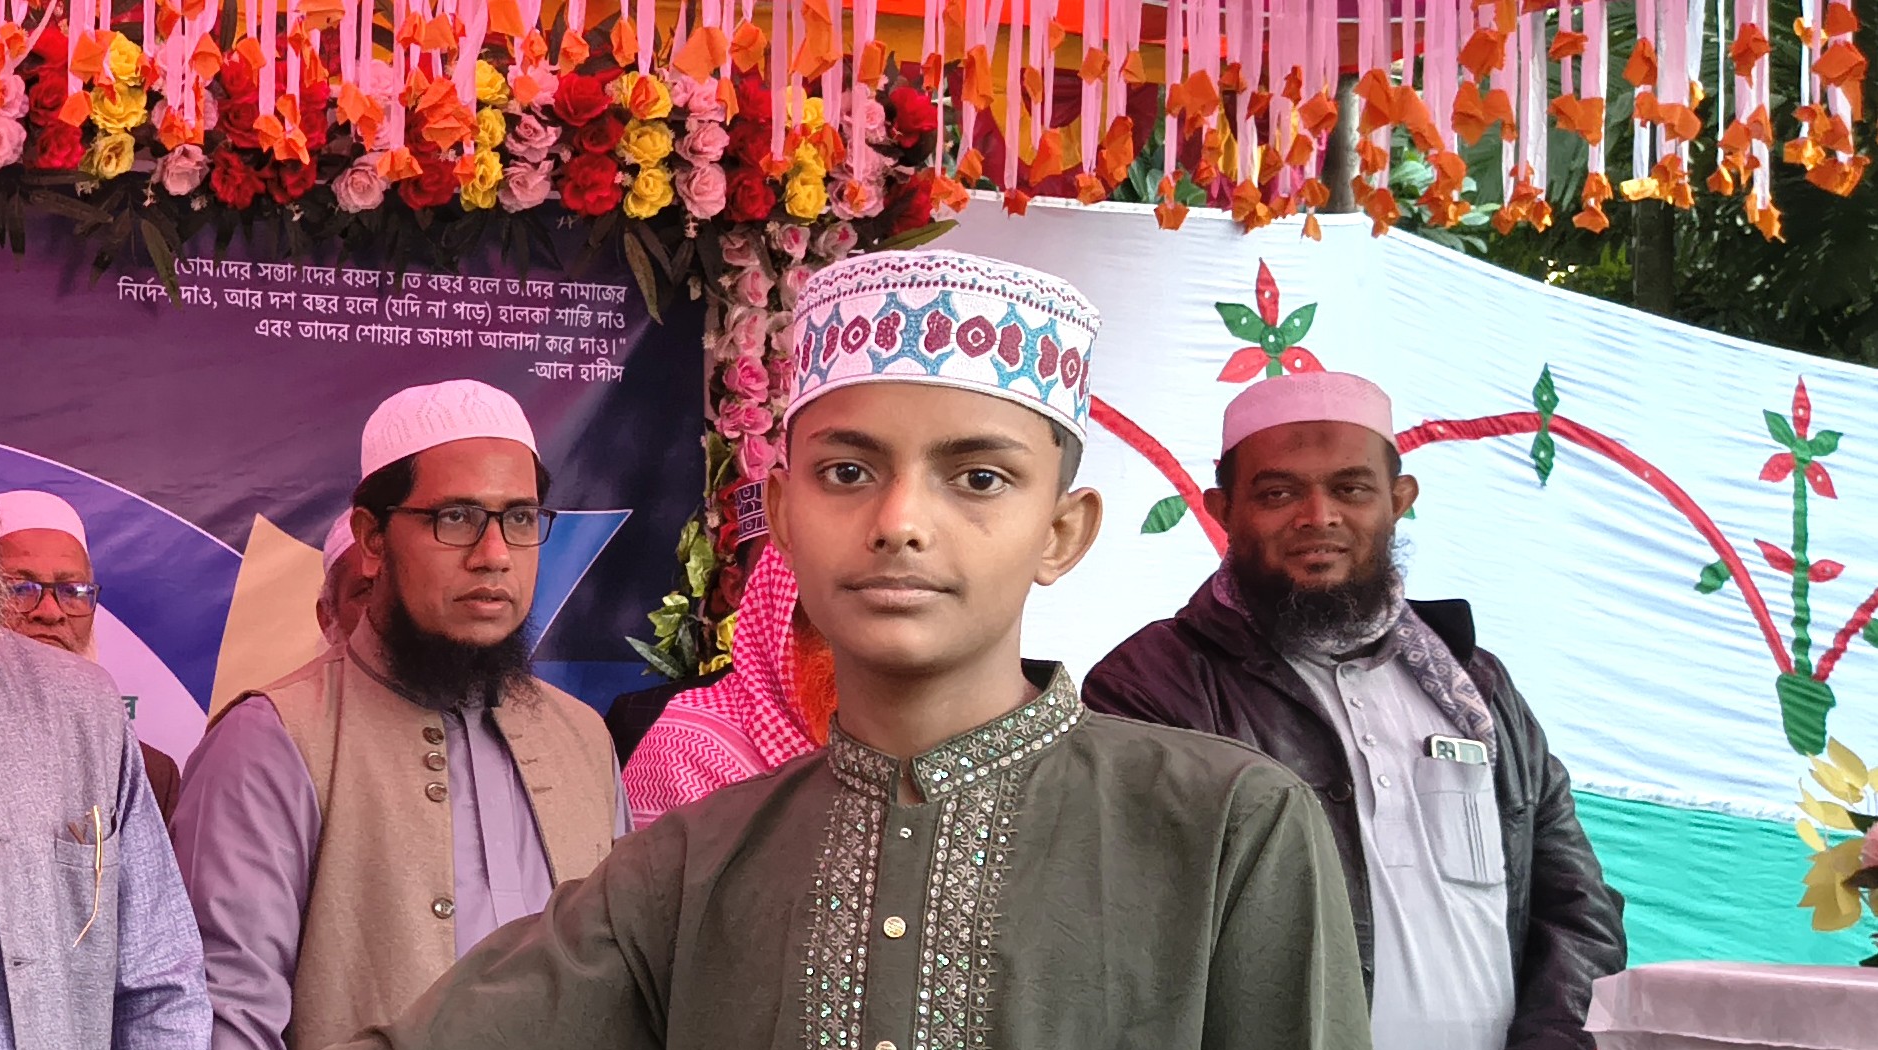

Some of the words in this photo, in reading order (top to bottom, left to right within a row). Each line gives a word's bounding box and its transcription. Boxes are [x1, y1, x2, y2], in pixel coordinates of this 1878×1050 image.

[342, 268, 381, 288] বয়স
[468, 276, 501, 295] হলে
[559, 281, 627, 304] নামাজের
[223, 287, 263, 310] আর
[268, 290, 297, 311] দশ
[301, 293, 340, 314] বছর
[344, 296, 378, 316] হলে
[427, 299, 447, 319] না
[497, 304, 550, 325] হালকা
[555, 304, 593, 328] শাস্তি
[597, 310, 625, 329] দাও
[255, 319, 292, 338] এবং
[297, 320, 350, 343] তাদের
[356, 323, 412, 347] শোয়ার
[417, 327, 473, 348] জায়গা
[478, 330, 541, 351] আলাদা
[545, 334, 574, 355] করে
[528, 361, 574, 381] -আল
[579, 357, 625, 383] হাদীস
